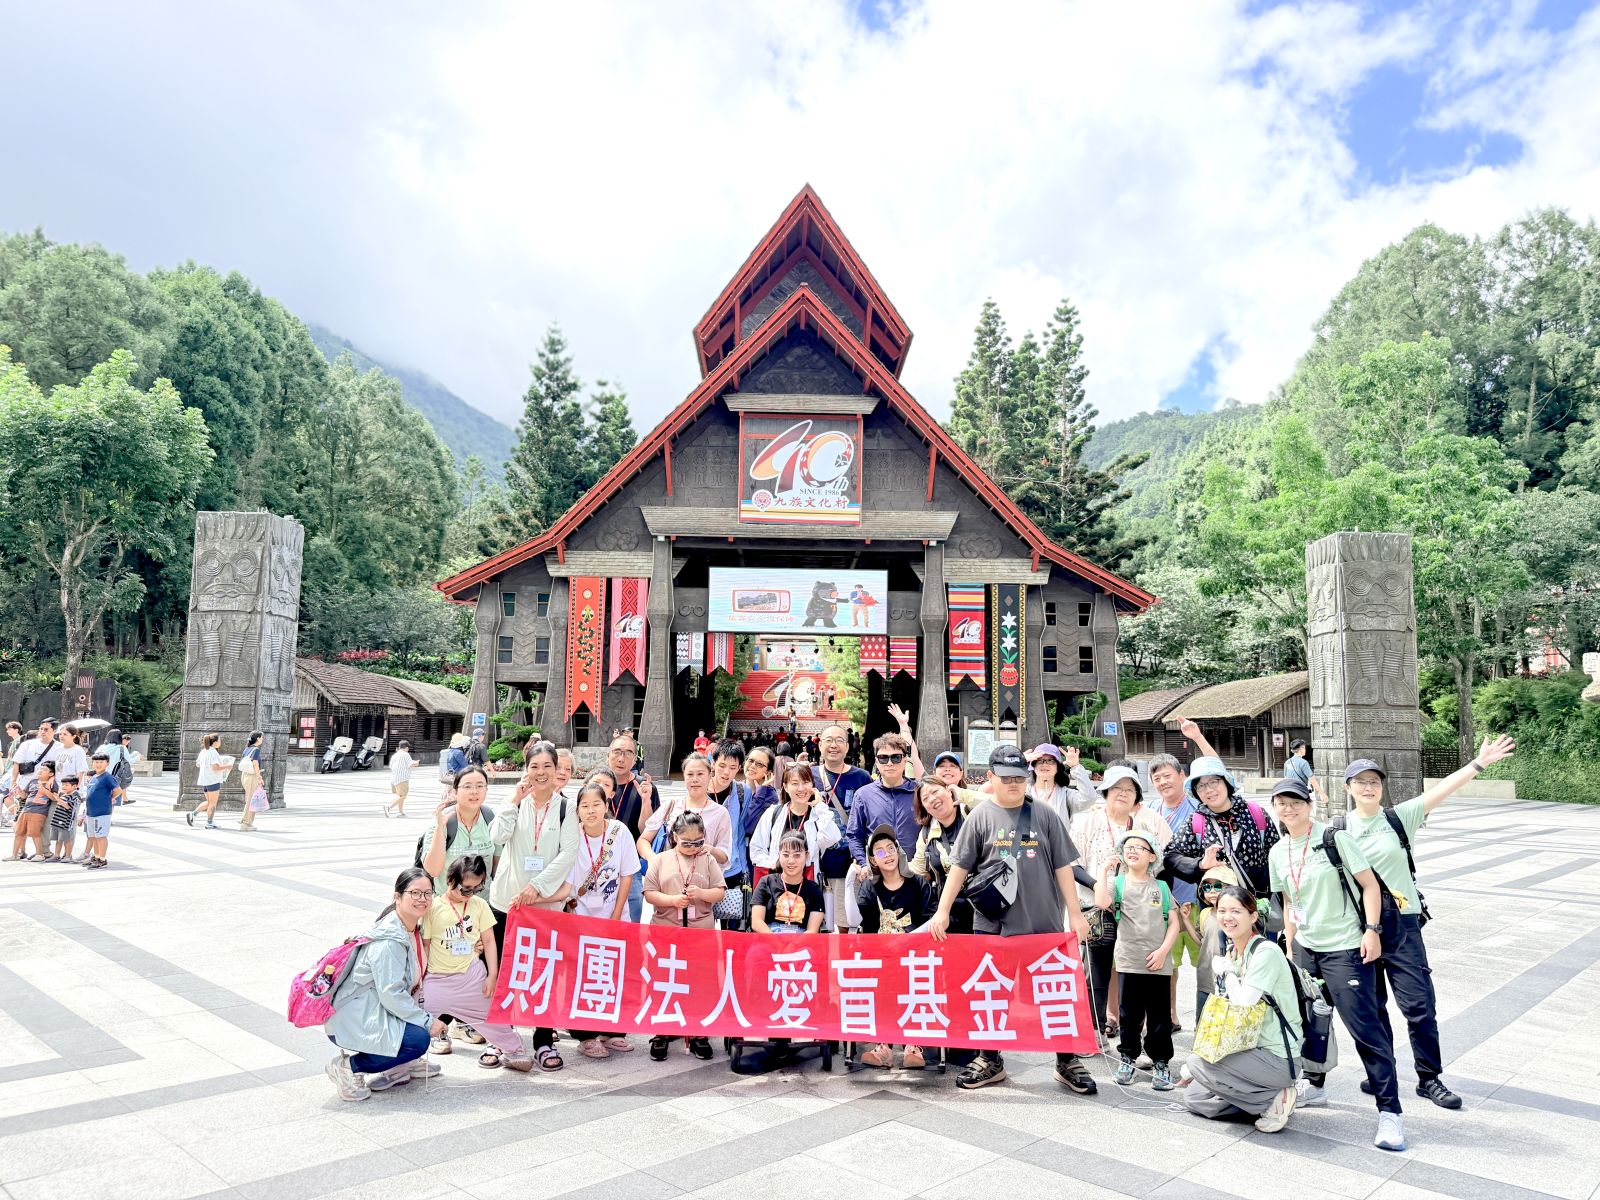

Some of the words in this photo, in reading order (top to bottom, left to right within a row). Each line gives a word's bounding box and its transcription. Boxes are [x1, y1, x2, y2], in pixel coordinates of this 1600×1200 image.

[799, 488, 823, 496] SINCE
[774, 496, 848, 509] 九族文化村
[499, 926, 1080, 1041] 財團法人愛盲基金會
